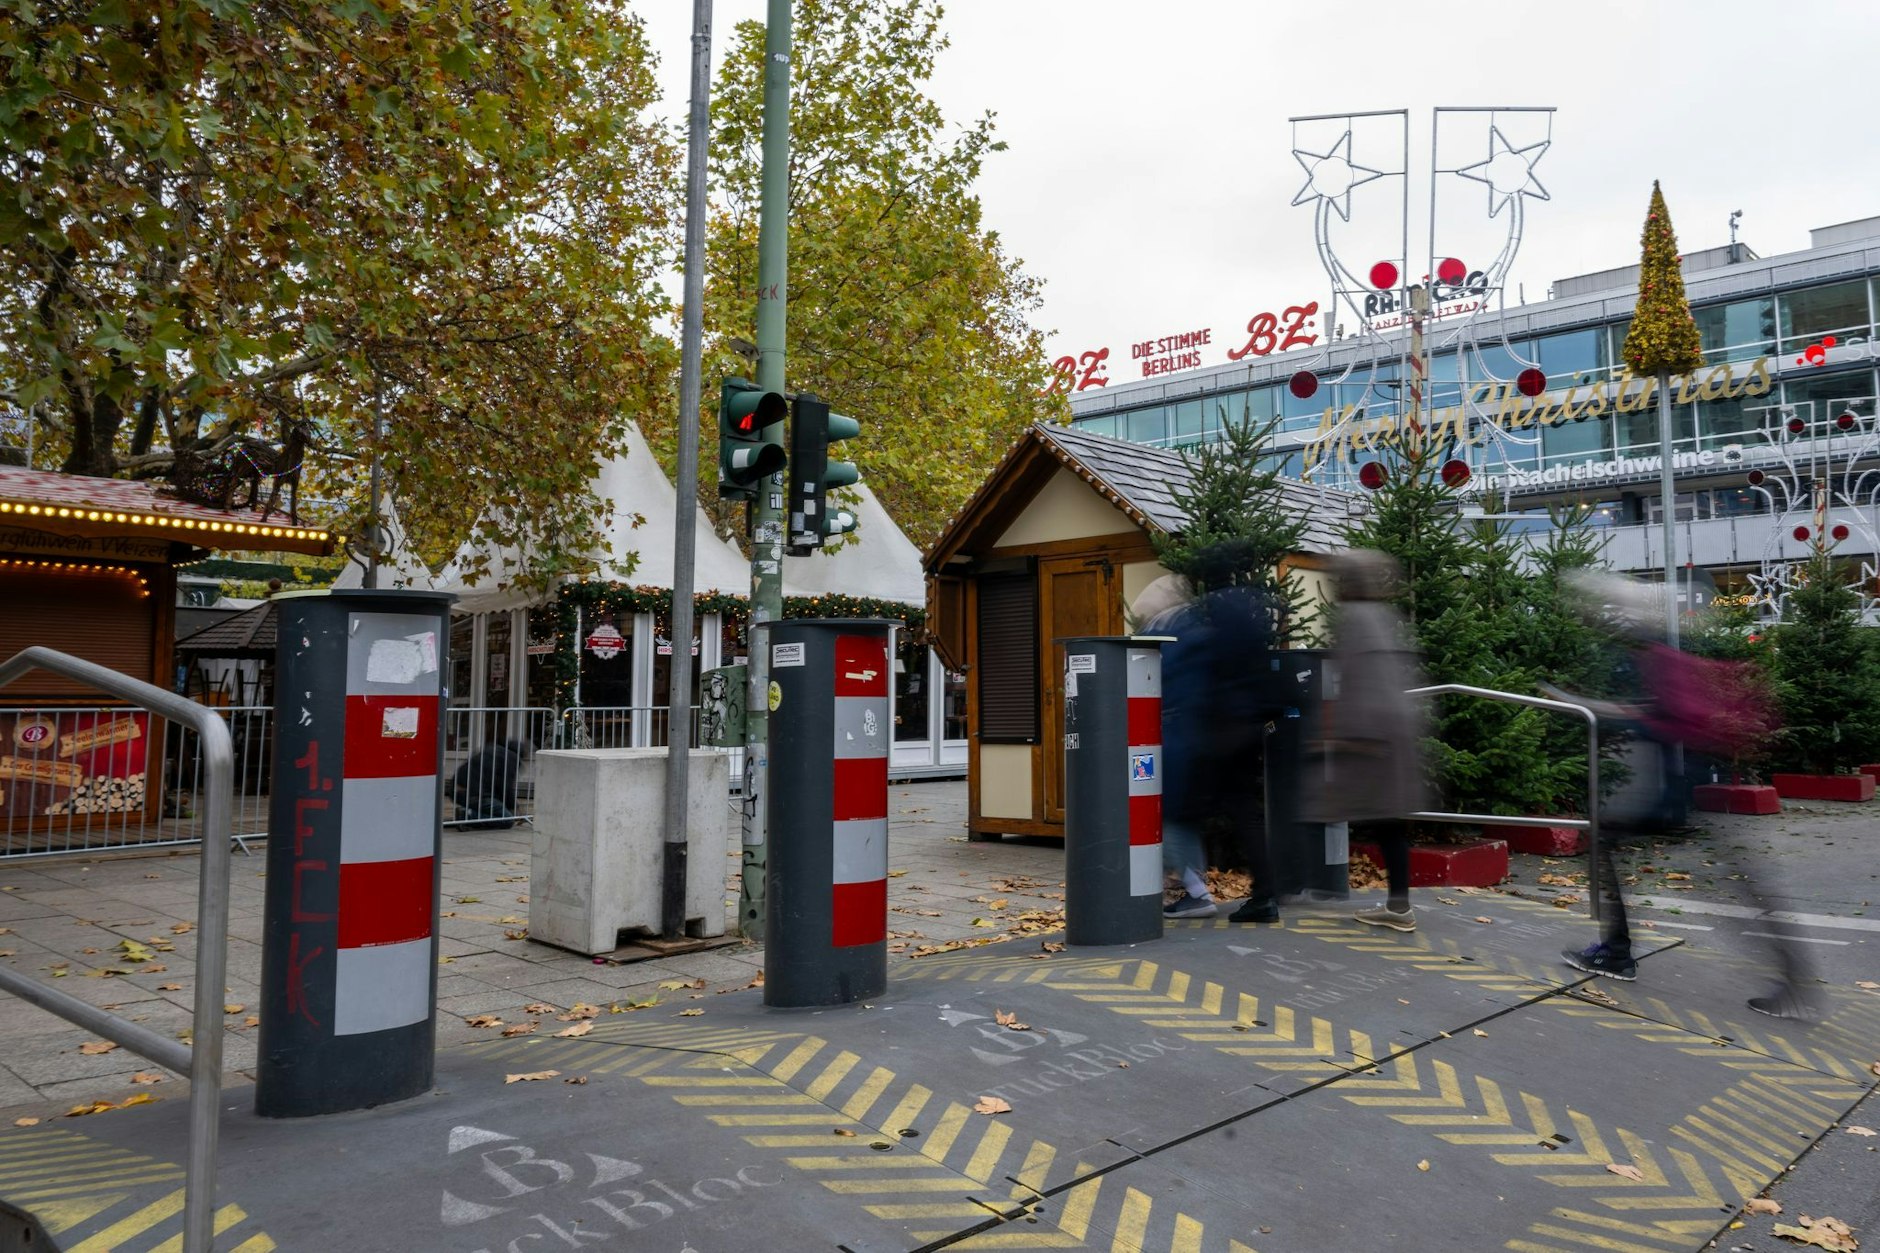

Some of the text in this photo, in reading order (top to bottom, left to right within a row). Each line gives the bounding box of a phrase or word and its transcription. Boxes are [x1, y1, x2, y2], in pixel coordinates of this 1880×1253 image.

[1132, 328, 1212, 360] DIE STIMME
[1142, 351, 1201, 377] BERLINS
[1507, 449, 1716, 487] Stachelschwine
